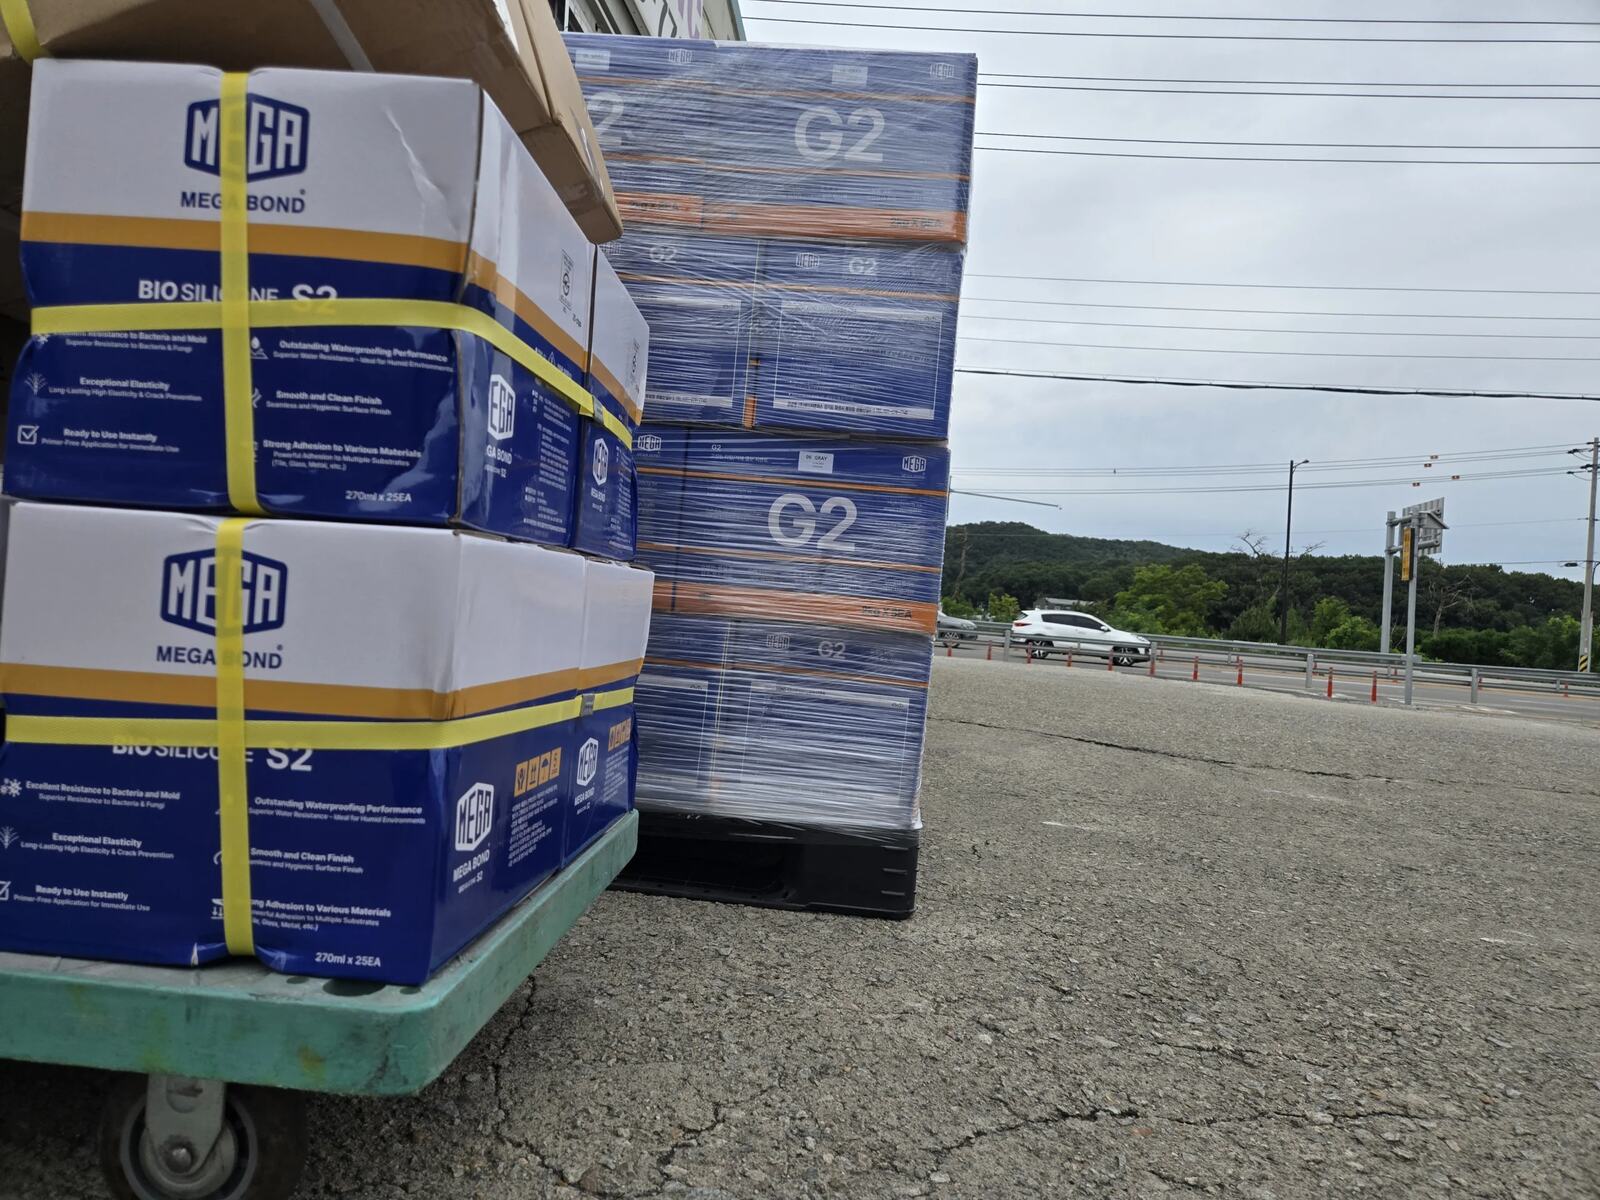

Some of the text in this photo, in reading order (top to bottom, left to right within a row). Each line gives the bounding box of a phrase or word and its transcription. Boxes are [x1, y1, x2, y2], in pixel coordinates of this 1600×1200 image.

[794, 105, 886, 162] G2
[247, 194, 305, 213] BOND
[138, 280, 338, 306] BIOSILINE S2
[279, 340, 448, 362] Outstanding Waterproofing Performance
[80, 377, 170, 391] Exceptional Elasticity
[276, 390, 382, 405] Smooth and Clean Finish
[63, 428, 157, 443] Ready to Use Instantly
[638, 433, 662, 451] MEGA
[263, 439, 422, 458] Strong Adhesion to Various Materials
[902, 455, 927, 473] MEGA
[345, 490, 377, 501] 270ml
[386, 491, 412, 503] 25EA
[768, 493, 858, 551] G2
[165, 558, 282, 629] MEGA
[156, 645, 283, 670] MEGA OND
[266, 744, 312, 772] S2
[25, 780, 181, 800] Excellent Resistance to Bacteria and Mold
[255, 796, 423, 815] Outstanding Waterproofing Performance
[457, 787, 492, 845] MEGA
[52, 832, 142, 849] Exceptional Elasticity
[250, 847, 355, 864] Smooth and Clean Finish
[453, 848, 490, 882] MEGA BOND
[35, 885, 129, 901] Ready to Use Instantly
[265, 900, 304, 911] Adhesion
[305, 903, 315, 912] to
[316, 904, 350, 914] Various
[350, 906, 392, 917] Materials
[315, 951, 381, 968] 270ml x 25EA
